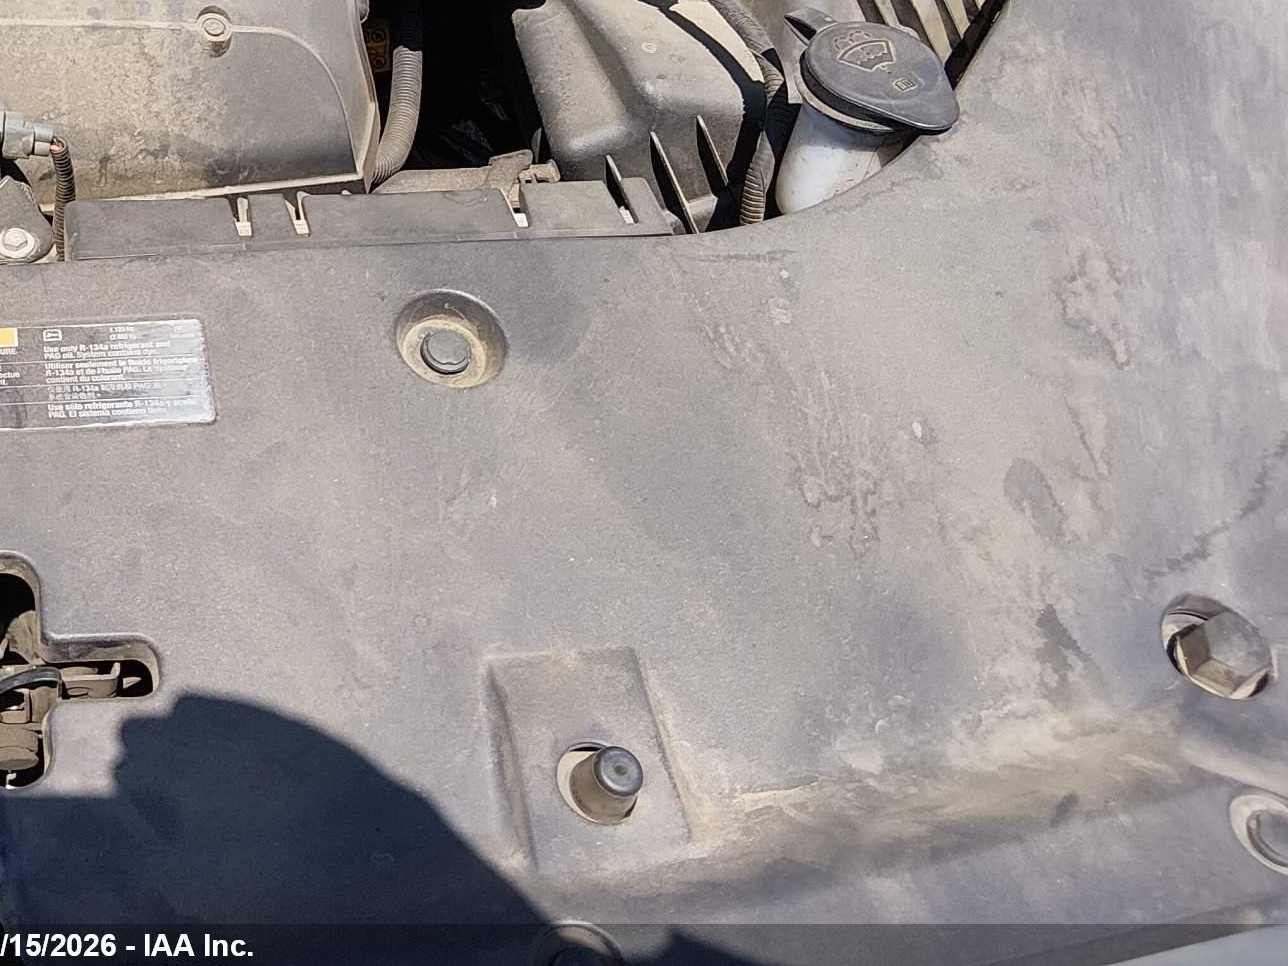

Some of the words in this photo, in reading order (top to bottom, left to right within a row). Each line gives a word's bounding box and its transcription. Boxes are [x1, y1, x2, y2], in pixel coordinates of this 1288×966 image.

[43, 345, 59, 353] Use
[60, 345, 78, 353] only
[79, 343, 109, 352] R-134a
[44, 352, 61, 360] PAG
[76, 351, 106, 360] System
[45, 362, 73, 370] Utiliser
[75, 360, 117, 369] seulement
[45, 368, 74, 376] R-134a
[75, 367, 84, 375] et
[85, 367, 96, 375] de
[72, 384, 99, 392] R-134a
[47, 403, 64, 411] Use
[84, 400, 133, 410] refrigerante
[78, 409, 110, 418] sistema
